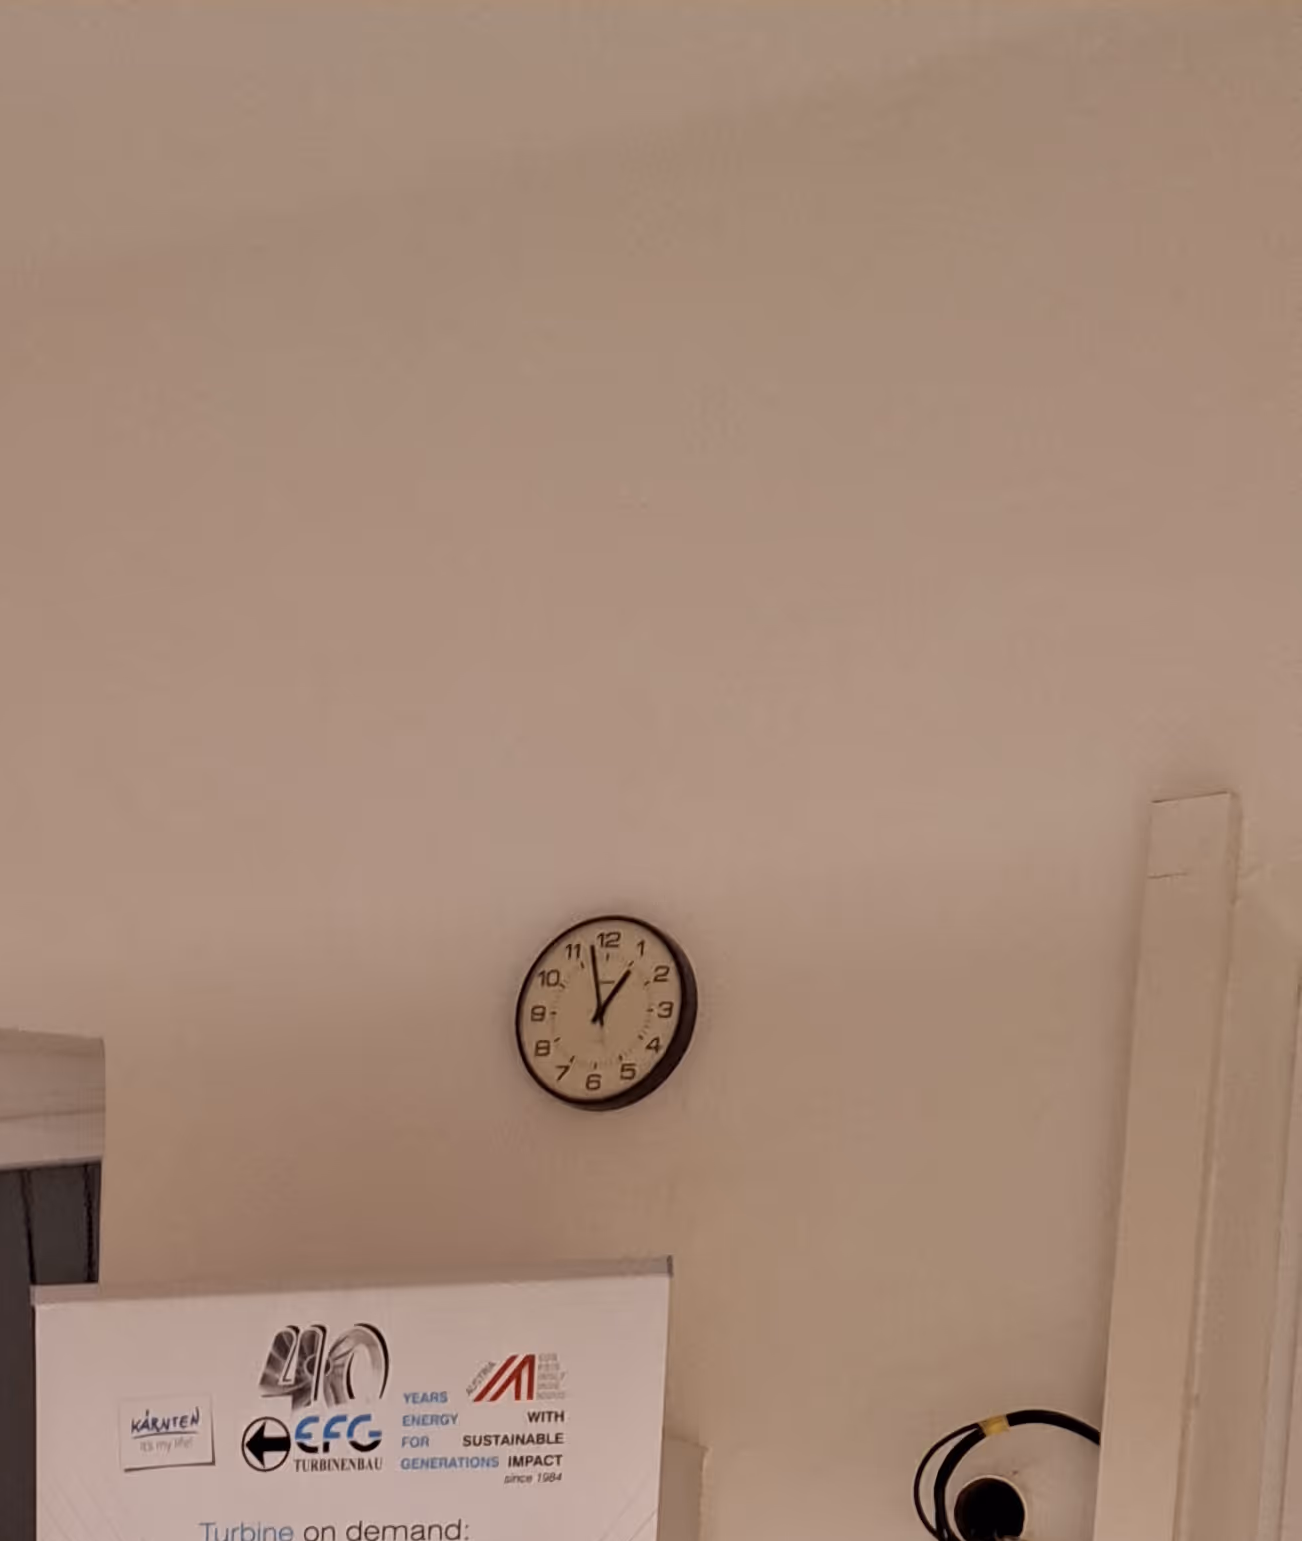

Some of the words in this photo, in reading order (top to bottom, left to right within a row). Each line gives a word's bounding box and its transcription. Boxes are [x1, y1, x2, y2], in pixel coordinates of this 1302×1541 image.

[597, 931, 621, 948] 12
[565, 943, 581, 960] 11
[636, 940, 646, 957] 1
[538, 969, 560, 987] 10
[653, 965, 670, 982] 2
[530, 1005, 546, 1022] 9
[657, 1001, 674, 1018] 3
[534, 1039, 551, 1057] 8
[645, 1036, 661, 1053] 4
[555, 1064, 570, 1082] 7
[620, 1062, 637, 1080] 5
[585, 1073, 602, 1091] 6
[465, 1361, 497, 1396] AUSTRIA
[402, 1391, 449, 1404] YEARS
[402, 1413, 458, 1427] ENERGY
[527, 1410, 565, 1423] WITH
[294, 1413, 382, 1453] EFG
[462, 1432, 564, 1447] SUSTAINABLE
[401, 1436, 429, 1448] FOR
[293, 1457, 383, 1472] TURBINENBAU
[400, 1456, 499, 1470] GENERATIONS
[507, 1454, 563, 1468] IMPACT
[503, 1473, 533, 1484] since
[537, 1472, 562, 1483] 1984
[345, 1519, 469, 1541] demand:
